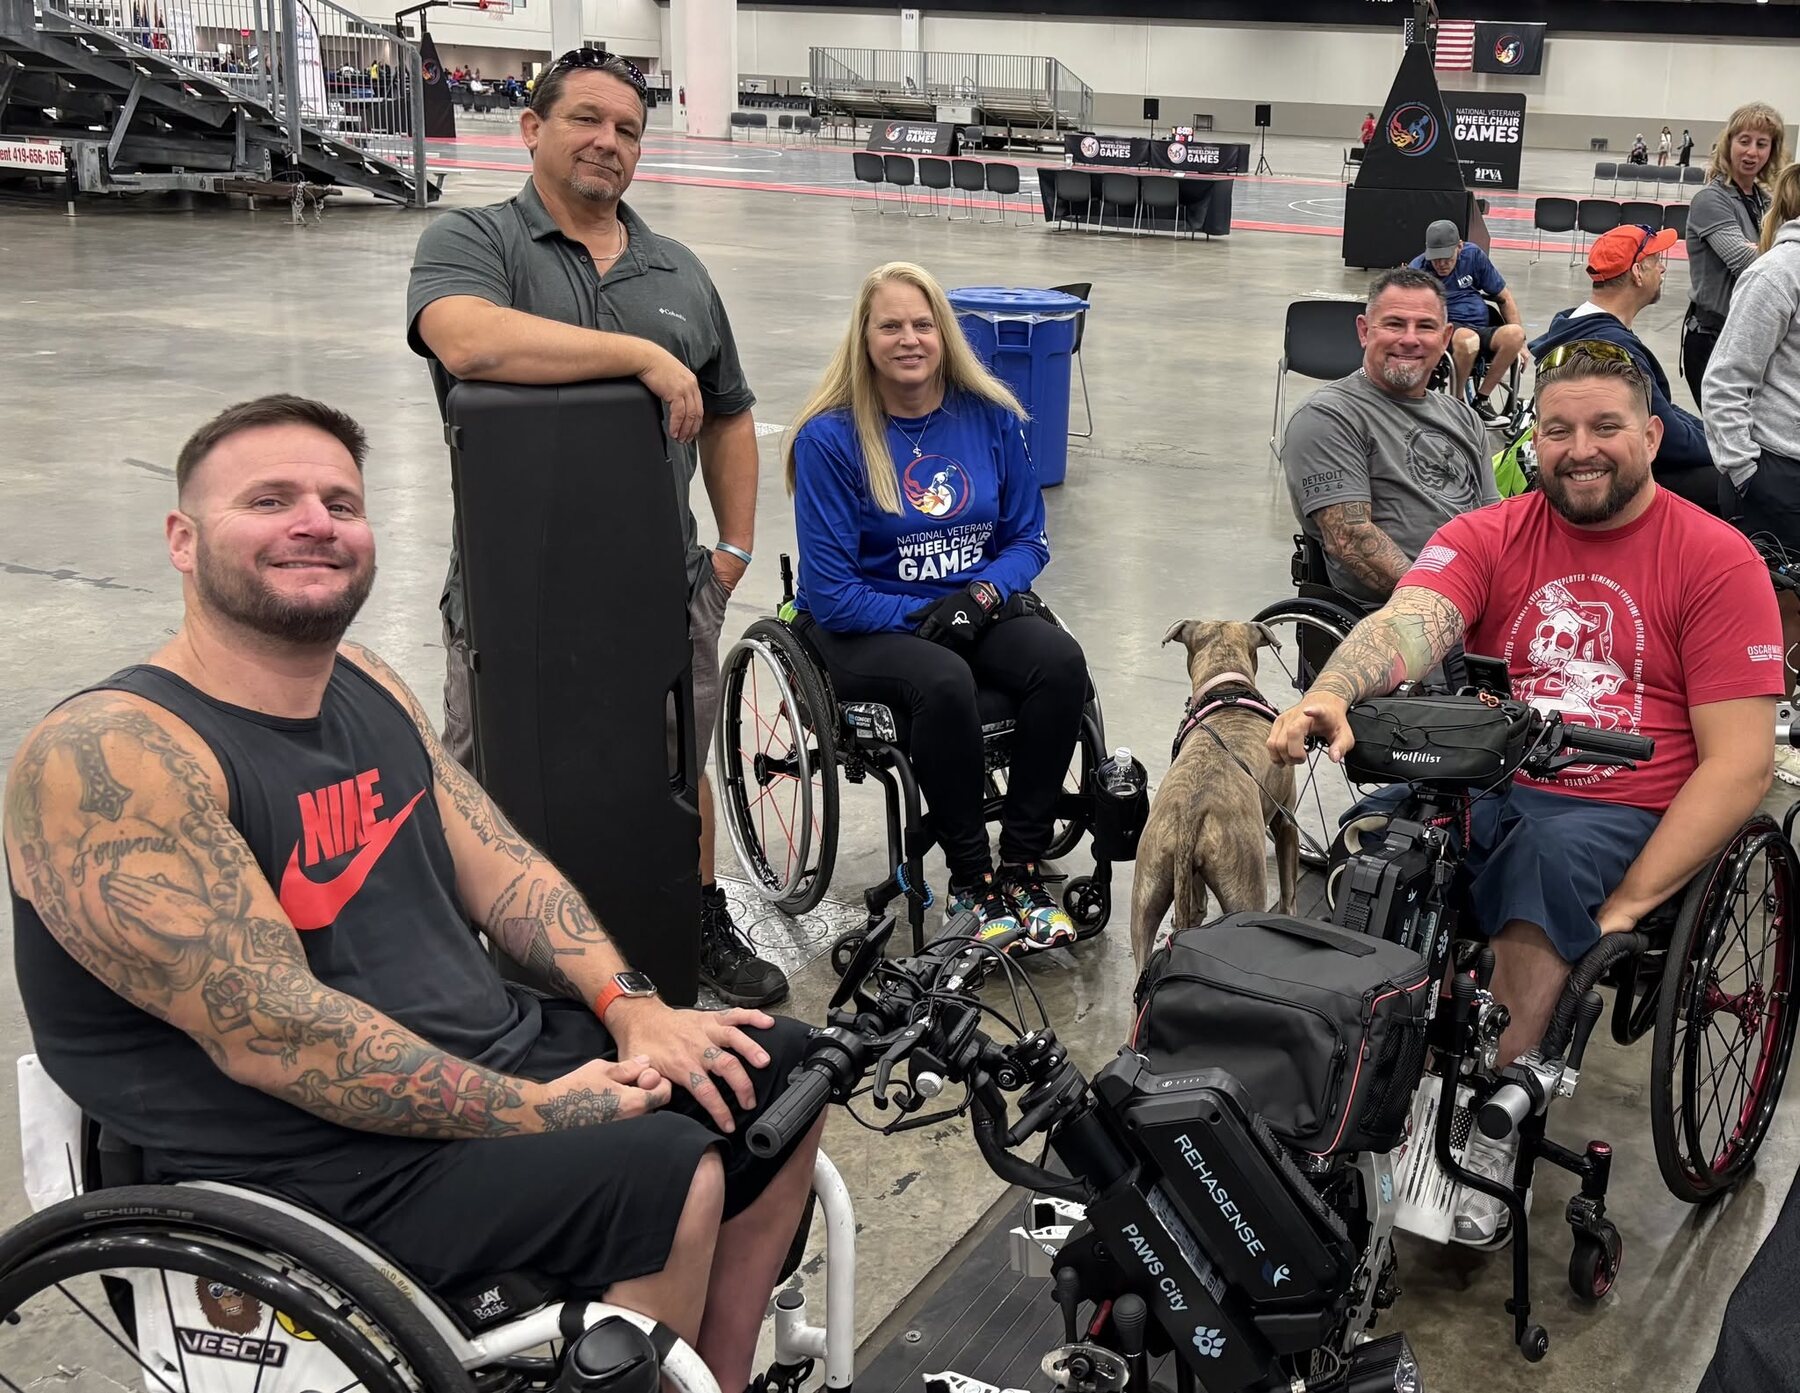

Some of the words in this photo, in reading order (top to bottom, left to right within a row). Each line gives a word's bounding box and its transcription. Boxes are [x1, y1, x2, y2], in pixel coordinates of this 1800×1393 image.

[1455, 114, 1519, 126] WHEELCHAIR
[1456, 107, 1486, 116] NATIONAL
[1487, 109, 1521, 117] VETERANS
[905, 134, 936, 143] GAMES
[1454, 124, 1519, 143] GAMES
[13, 147, 63, 166] 419-656-1657
[1099, 149, 1131, 158] GAMES
[1187, 154, 1220, 164] GAMES
[1480, 168, 1502, 181] PVA
[1302, 470, 1343, 487] DETROIT
[896, 529, 944, 545] NATIONAL
[946, 521, 993, 537] VETERANS
[898, 531, 991, 558] WHEELCHAIR
[898, 541, 986, 582] GAMES
[1590, 573, 1621, 592] REMEMBER
[297, 768, 390, 867] NIKE
[543, 886, 564, 927] FOREVER
[1173, 1134, 1267, 1258] REHASENSE
[83, 1207, 195, 1221] SCHWALBE
[1121, 1223, 1165, 1276] PAWS
[1158, 1277, 1188, 1312] City
[473, 1301, 509, 1320] Basic
[180, 1331, 282, 1364] VESCO
